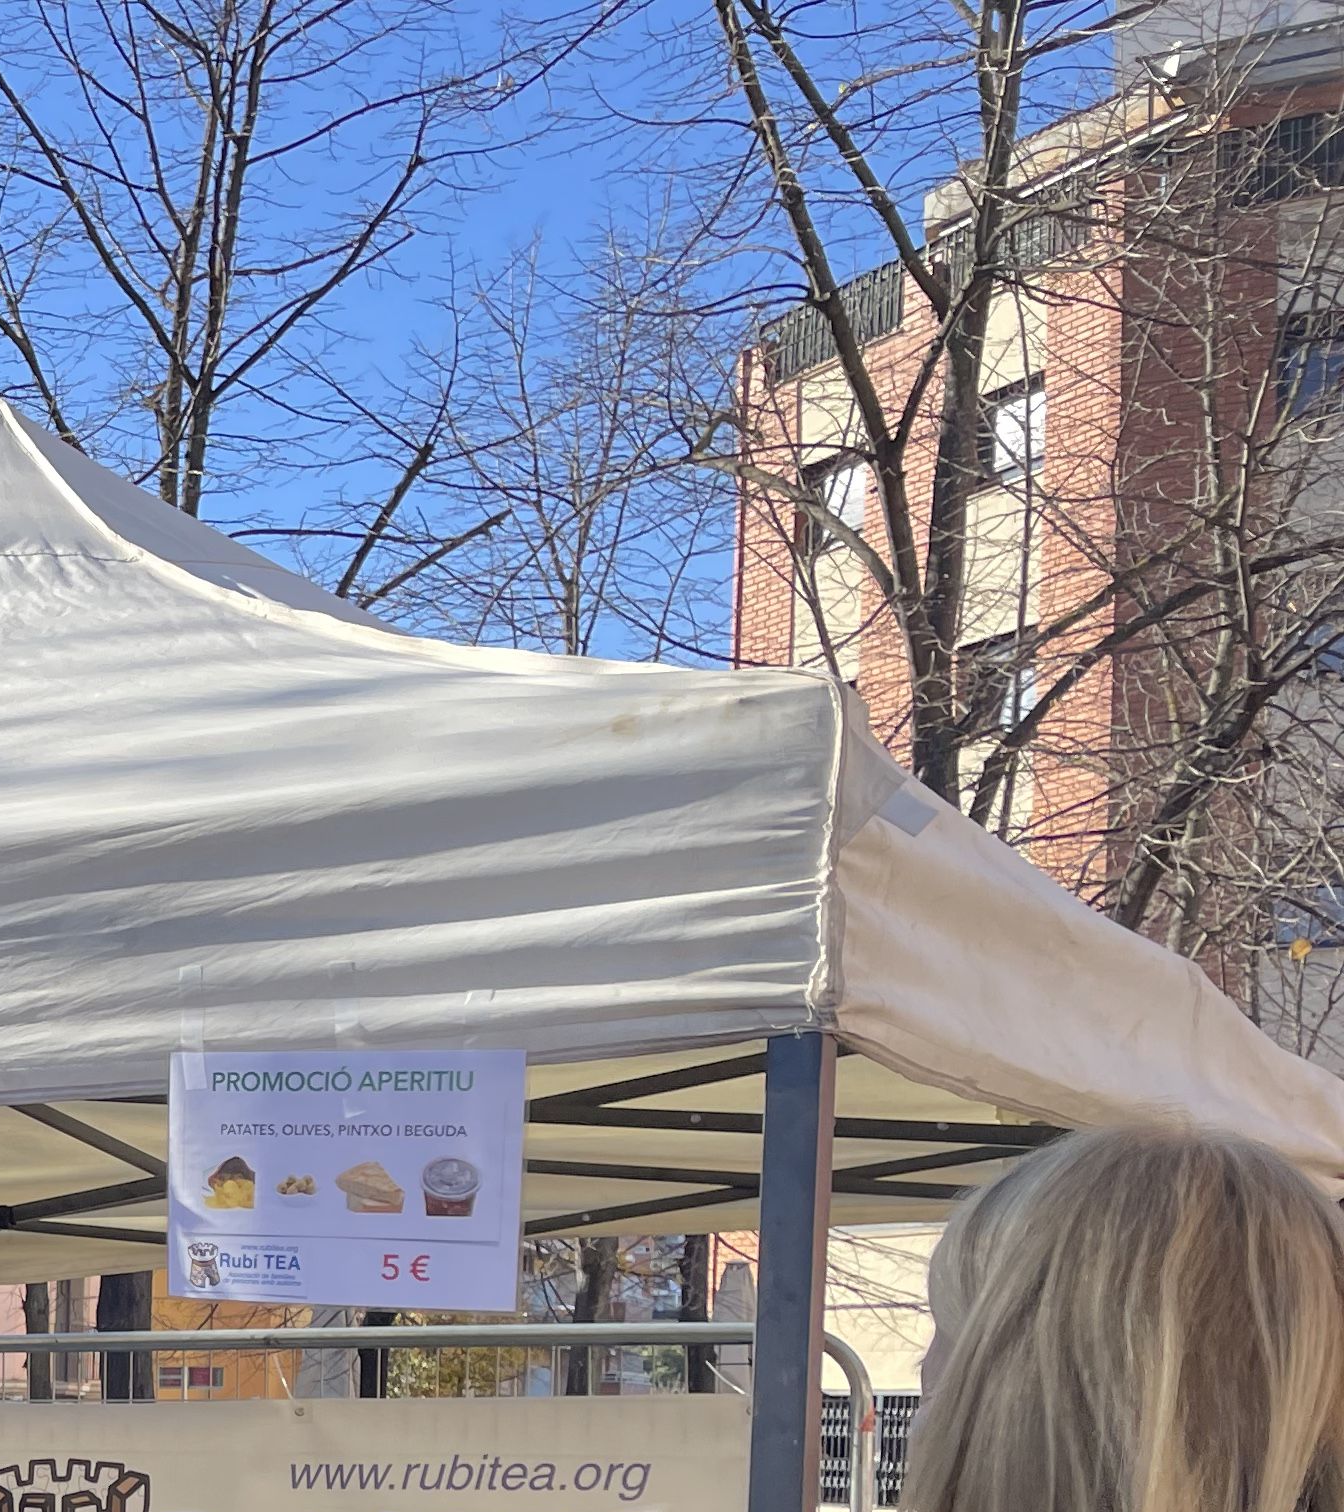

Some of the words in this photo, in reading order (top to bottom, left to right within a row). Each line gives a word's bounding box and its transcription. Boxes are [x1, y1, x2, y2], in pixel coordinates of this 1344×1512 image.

[211, 1067, 352, 1093] PROMOCIÓ
[357, 1070, 474, 1092] APERITIU
[220, 1124, 279, 1138] PATATES,
[282, 1123, 335, 1138] OLIVES,
[337, 1125, 393, 1138] PINTXO
[404, 1125, 468, 1138] BEGUDA
[219, 1252, 258, 1269] Rubí
[263, 1255, 301, 1270] TEA
[381, 1254, 400, 1281] 5
[409, 1255, 430, 1281] €
[290, 1455, 651, 1500] www.rubitea.org
